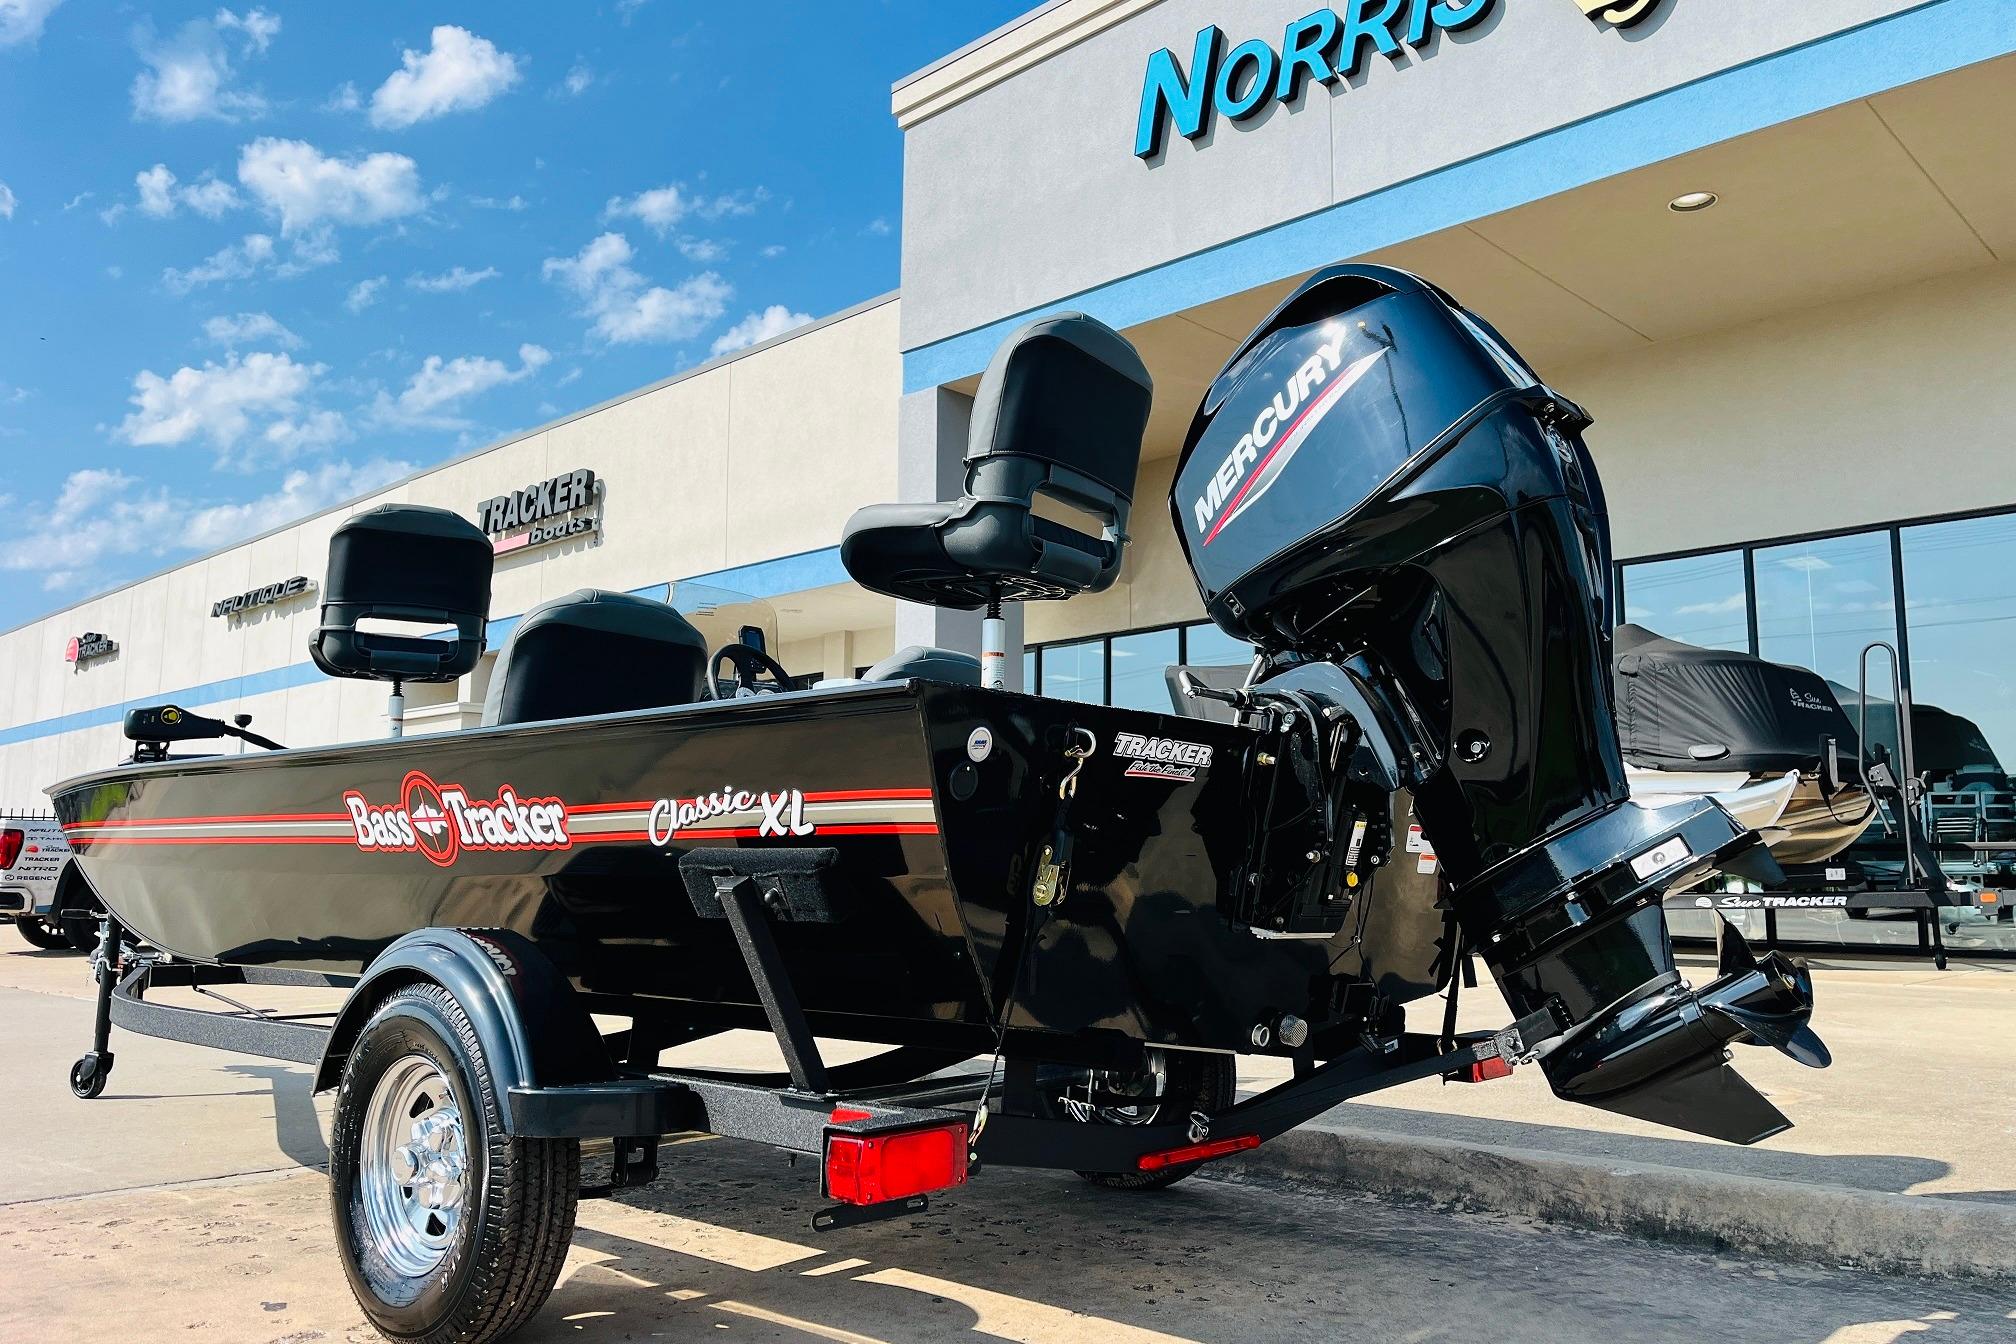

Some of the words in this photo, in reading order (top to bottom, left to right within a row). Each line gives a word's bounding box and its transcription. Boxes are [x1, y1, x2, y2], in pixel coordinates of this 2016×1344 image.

[1193, 321, 1348, 534] MERCURY
[477, 468, 594, 536] TRACKER
[530, 516, 589, 545] boats
[210, 576, 308, 618] NAUTIQUE
[79, 639, 110, 659] TRACKER
[1790, 699, 1833, 712] TRACKER
[1113, 732, 1213, 767] TRACKER
[345, 795, 417, 847] Bass
[440, 789, 570, 847] Tracker
[648, 785, 757, 847] Classic
[759, 788, 816, 839] XL
[1716, 896, 1763, 908] Sun
[1762, 896, 1848, 907] TRACKER
